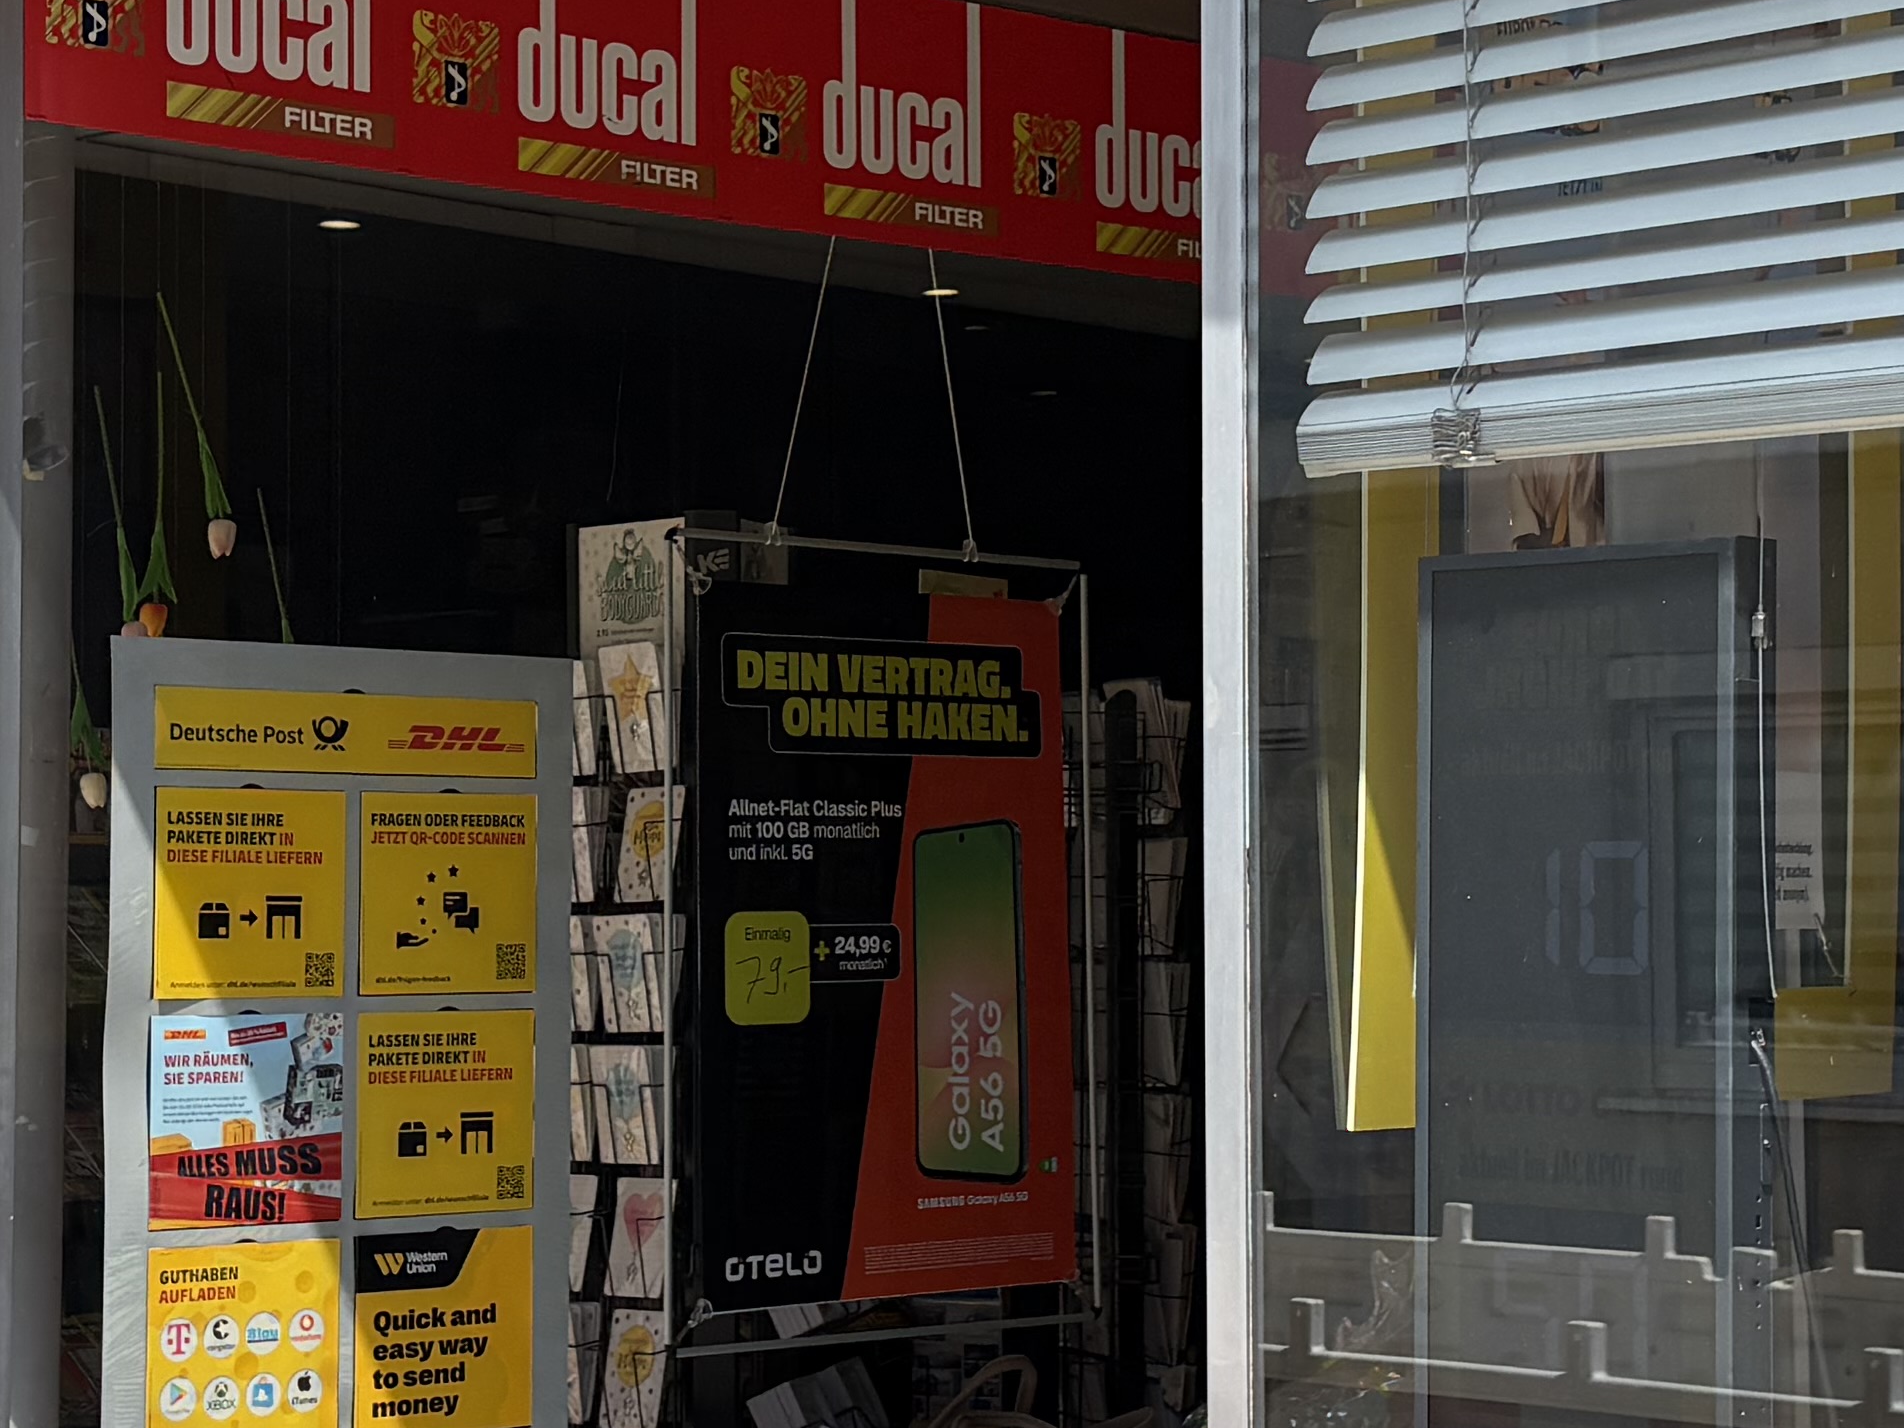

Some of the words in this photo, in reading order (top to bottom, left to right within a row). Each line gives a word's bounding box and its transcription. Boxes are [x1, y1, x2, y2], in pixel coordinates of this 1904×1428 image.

[283, 105, 374, 143] FILTER
[620, 158, 700, 192] FILTER
[913, 202, 984, 232] FILTER
[737, 649, 828, 691] DEIN
[837, 653, 1012, 699] VERTRAG.
[782, 697, 888, 738] OHNE
[897, 700, 1029, 742] HAKEN.
[169, 722, 258, 744] Deutsche
[263, 725, 305, 746] Post
[406, 725, 508, 752] DHL
[728, 799, 810, 817] Allnet-Flat
[813, 800, 868, 817] Classic
[871, 801, 903, 818] Plus
[167, 811, 223, 827] LASSEN
[226, 812, 249, 827] SIE
[252, 813, 285, 828] IHRE
[371, 813, 422, 827] FRAGEN
[426, 813, 458, 828] ODER
[461, 813, 525, 829] FEEDBACK
[167, 830, 222, 845] PAKETE
[225, 831, 277, 846] DIREKT
[279, 832, 294, 847] IN
[371, 830, 407, 845] JETZT
[409, 831, 466, 846] QR-CODE
[467, 831, 526, 846] SCANNEN
[729, 822, 752, 839] mit
[756, 822, 785, 839] 100
[788, 822, 810, 839] GB
[813, 822, 881, 839] monatlich
[167, 849, 209, 864] DIESE
[212, 850, 263, 864] FILIALE
[266, 851, 323, 865] LIEFERN
[729, 845, 757, 861] und
[760, 845, 789, 861] inkl.
[792, 844, 814, 861] 5G
[744, 927, 791, 942] Einmalig
[834, 935, 881, 957] 24,99
[882, 939, 892, 953] €
[976, 999, 1003, 1058] 5G
[368, 1034, 420, 1048] LASSEN
[423, 1033, 444, 1047] SIE
[446, 1032, 477, 1046] IHRE
[163, 1054, 190, 1069] WIR
[193, 1051, 254, 1069] RÄUMEN,
[368, 1052, 420, 1067] PAKETE
[422, 1050, 470, 1065] DIREKT
[472, 1050, 487, 1064] IN
[163, 1072, 185, 1086] SIE
[187, 1070, 245, 1086] SPAREN!
[368, 1070, 407, 1085] DIESE
[409, 1069, 458, 1084] FILIALE
[460, 1067, 513, 1082] LIEFERN
[947, 991, 975, 1151] Galaxy
[980, 1071, 1005, 1153] A56
[177, 1152, 229, 1178] ALLES
[234, 1142, 322, 1177] MUSS
[204, 1183, 287, 1223] RAUS!
[405, 1251, 448, 1263] Western
[159, 1266, 239, 1285] GUTHABEN
[406, 1262, 436, 1274] Union
[159, 1285, 236, 1304] AUFLADEN
[373, 1307, 447, 1337] Quick
[450, 1303, 496, 1327] and
[373, 1340, 434, 1362] easy
[438, 1336, 488, 1357] way
[372, 1369, 399, 1390] to
[403, 1361, 465, 1387] send
[206, 1399, 236, 1411] XBOX
[372, 1394, 459, 1418] money
